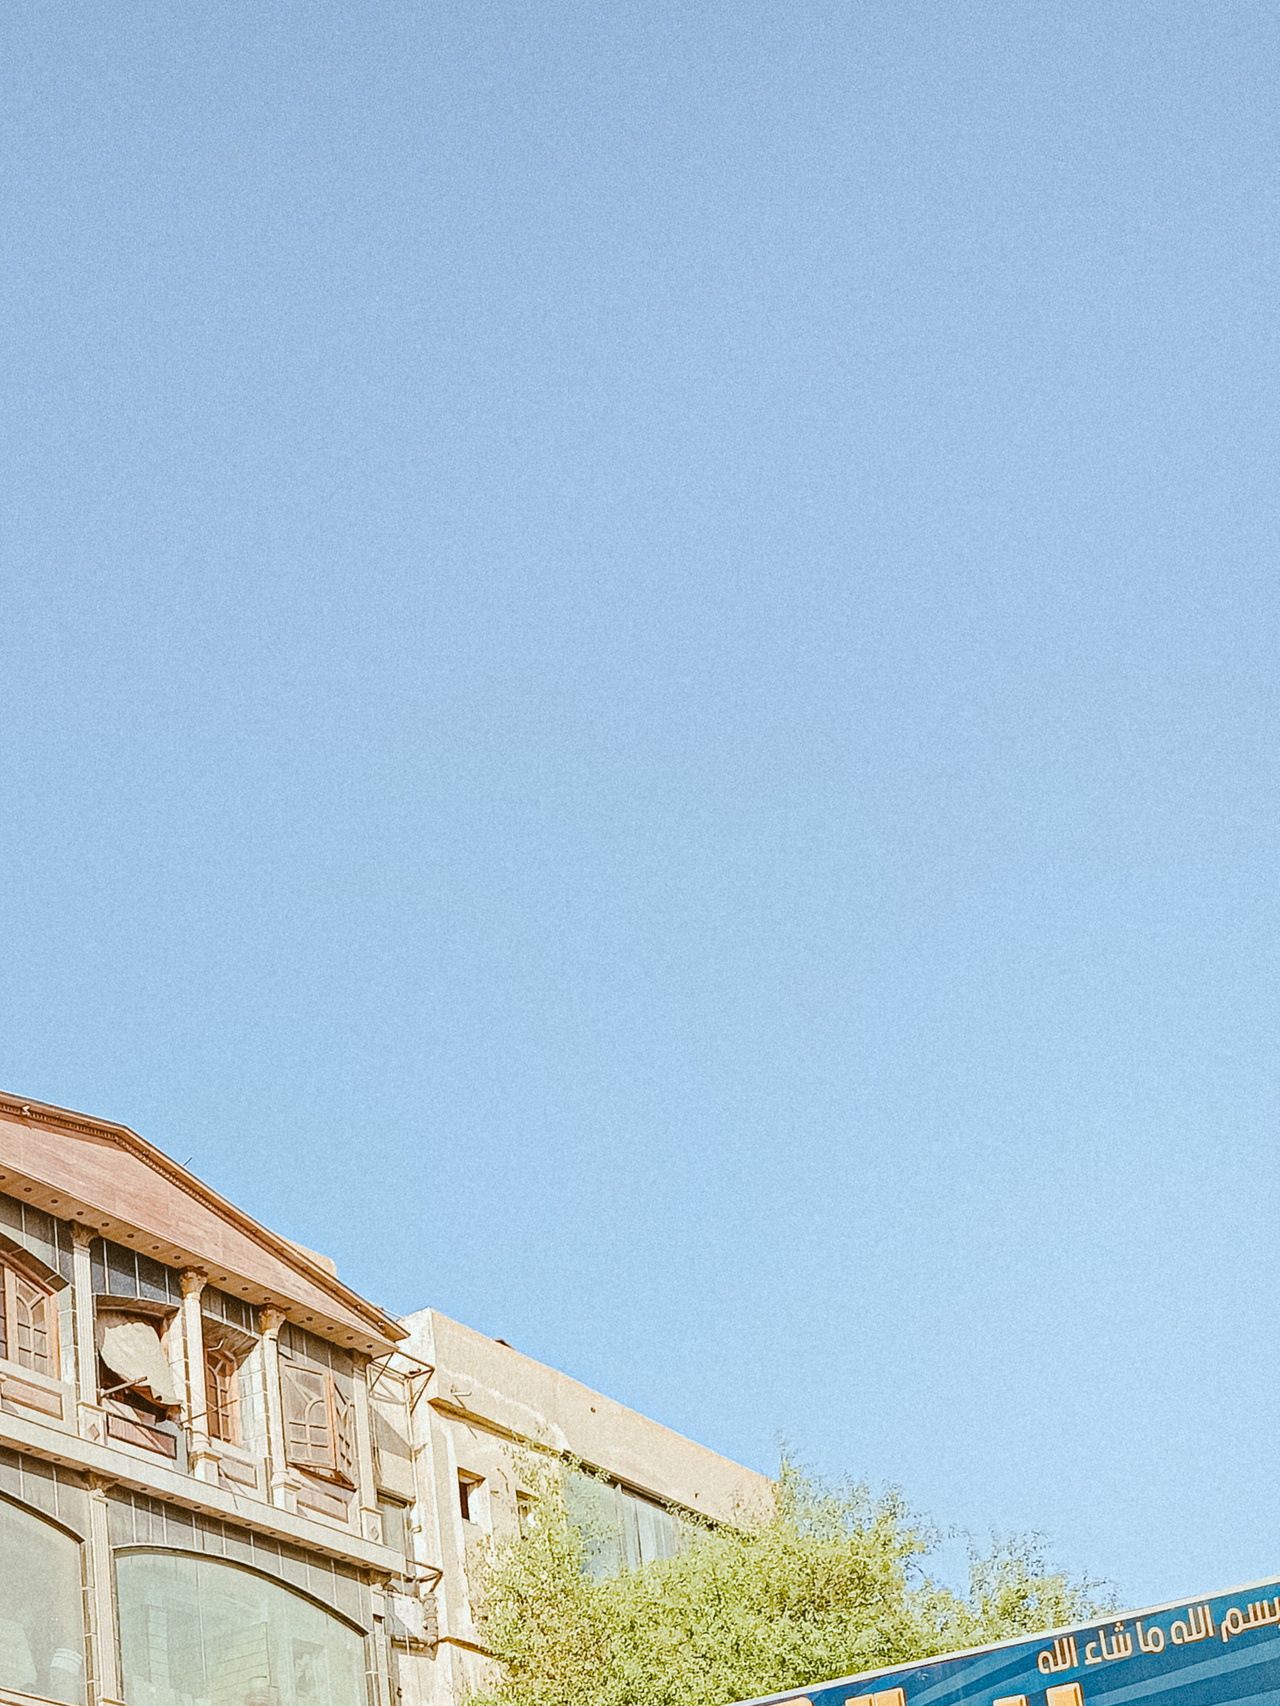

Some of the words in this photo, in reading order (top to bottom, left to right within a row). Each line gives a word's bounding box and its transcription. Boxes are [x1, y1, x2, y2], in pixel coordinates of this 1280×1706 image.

[1084, 1621, 1133, 1666] شاء
[1135, 1621, 1166, 1653] ما
[1170, 1604, 1216, 1646] الله
[1037, 1637, 1079, 1675] الله
